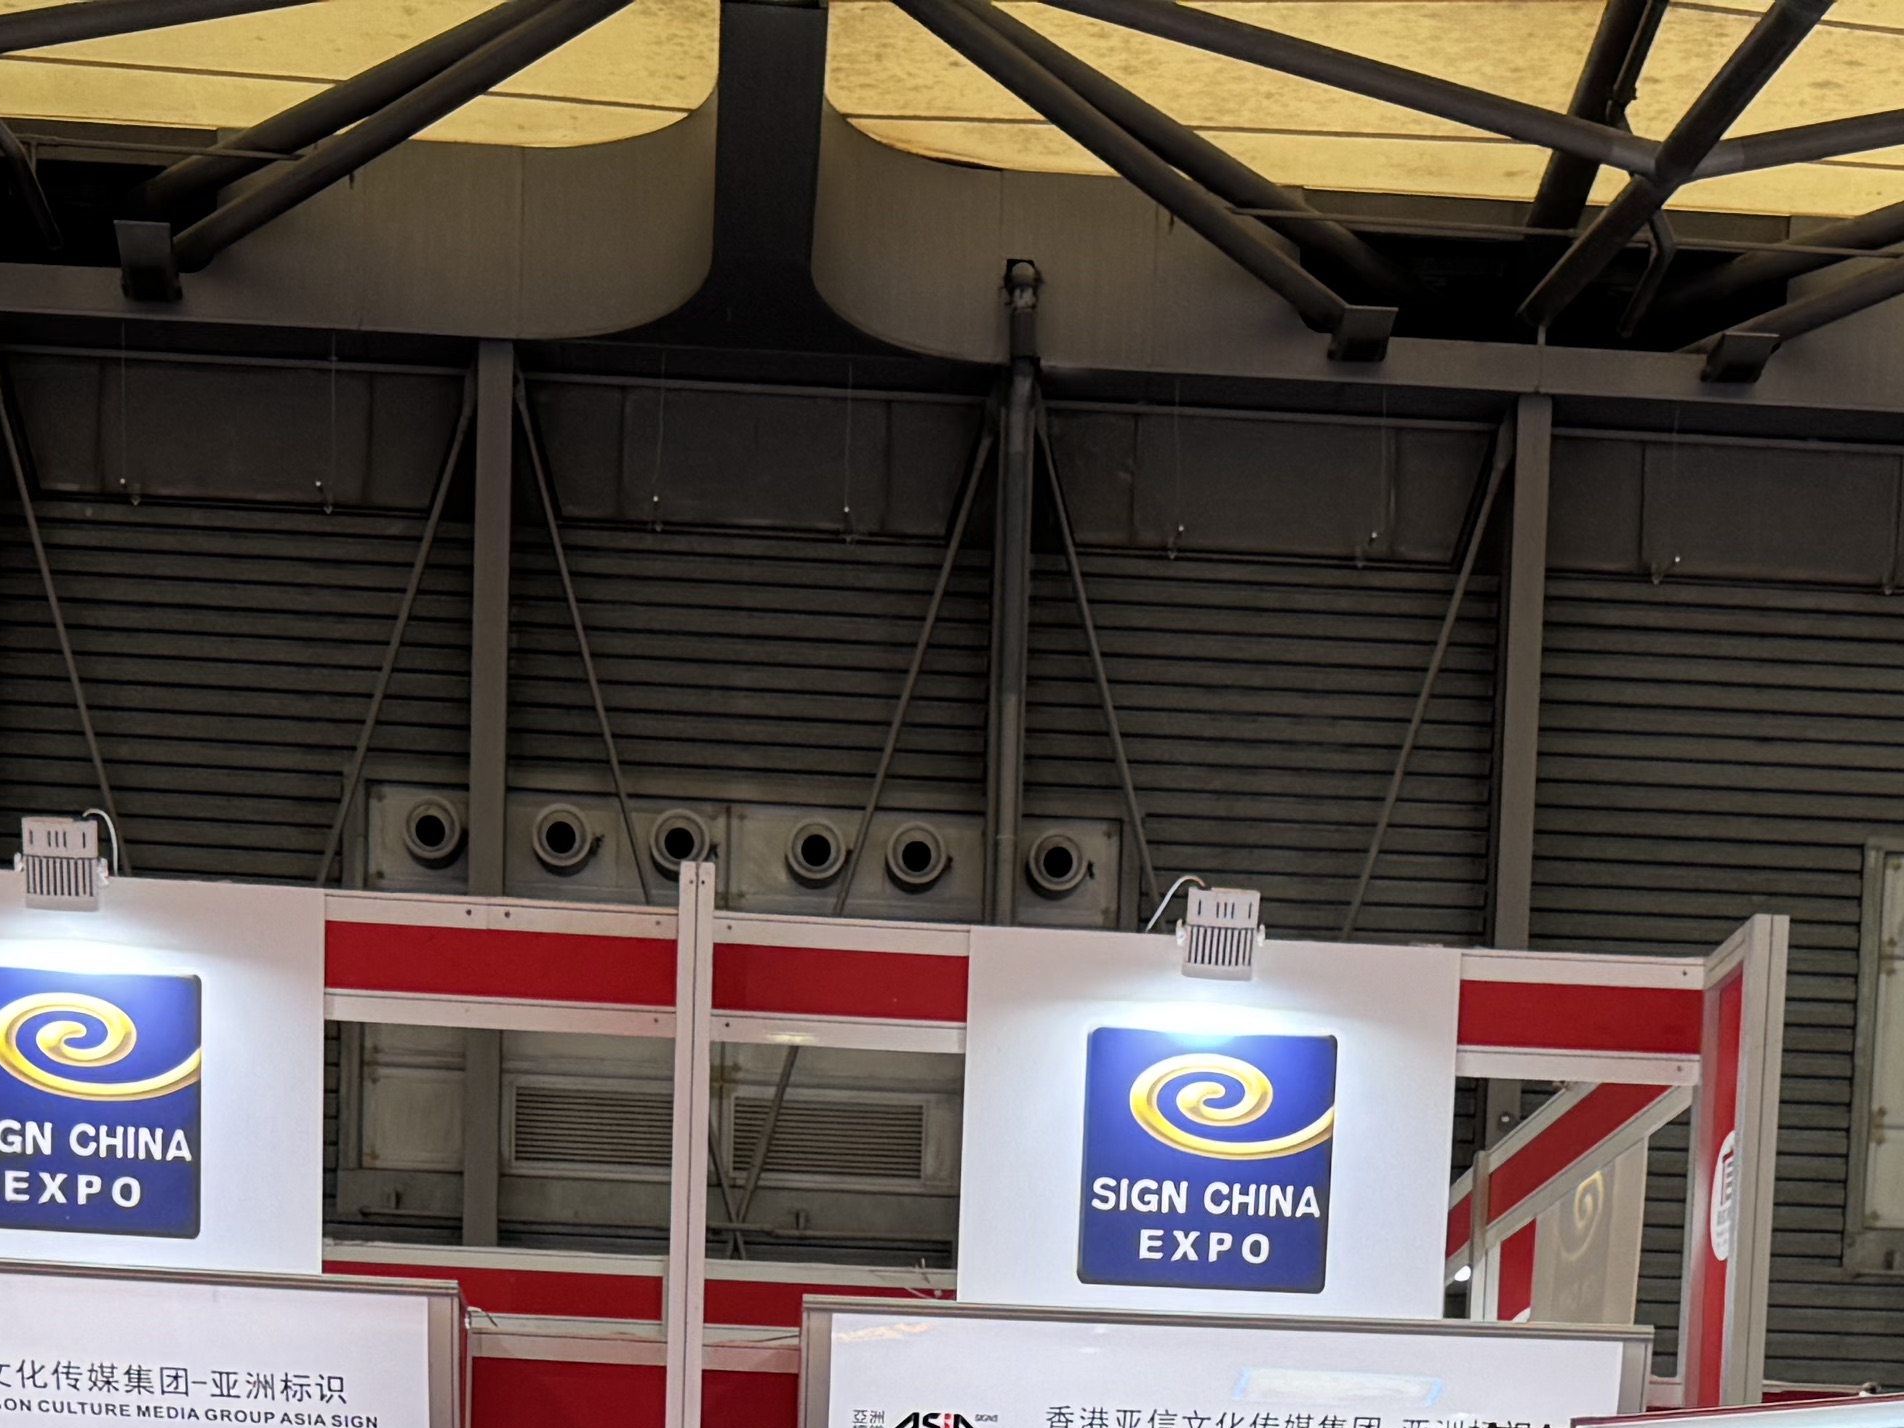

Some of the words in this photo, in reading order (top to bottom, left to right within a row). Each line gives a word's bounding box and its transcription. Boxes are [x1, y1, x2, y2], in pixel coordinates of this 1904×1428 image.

[68, 1122, 193, 1163] CHINA
[4, 1170, 142, 1208] EXPO
[1092, 1176, 1188, 1214] SIGN
[1203, 1182, 1322, 1220] CHINA
[1138, 1229, 1271, 1265] EXPO
[37, 1399, 132, 1418] CULTURE
[136, 1404, 200, 1421] MEDIA
[204, 1407, 276, 1425] GROUP
[280, 1411, 328, 1428] ASIA
